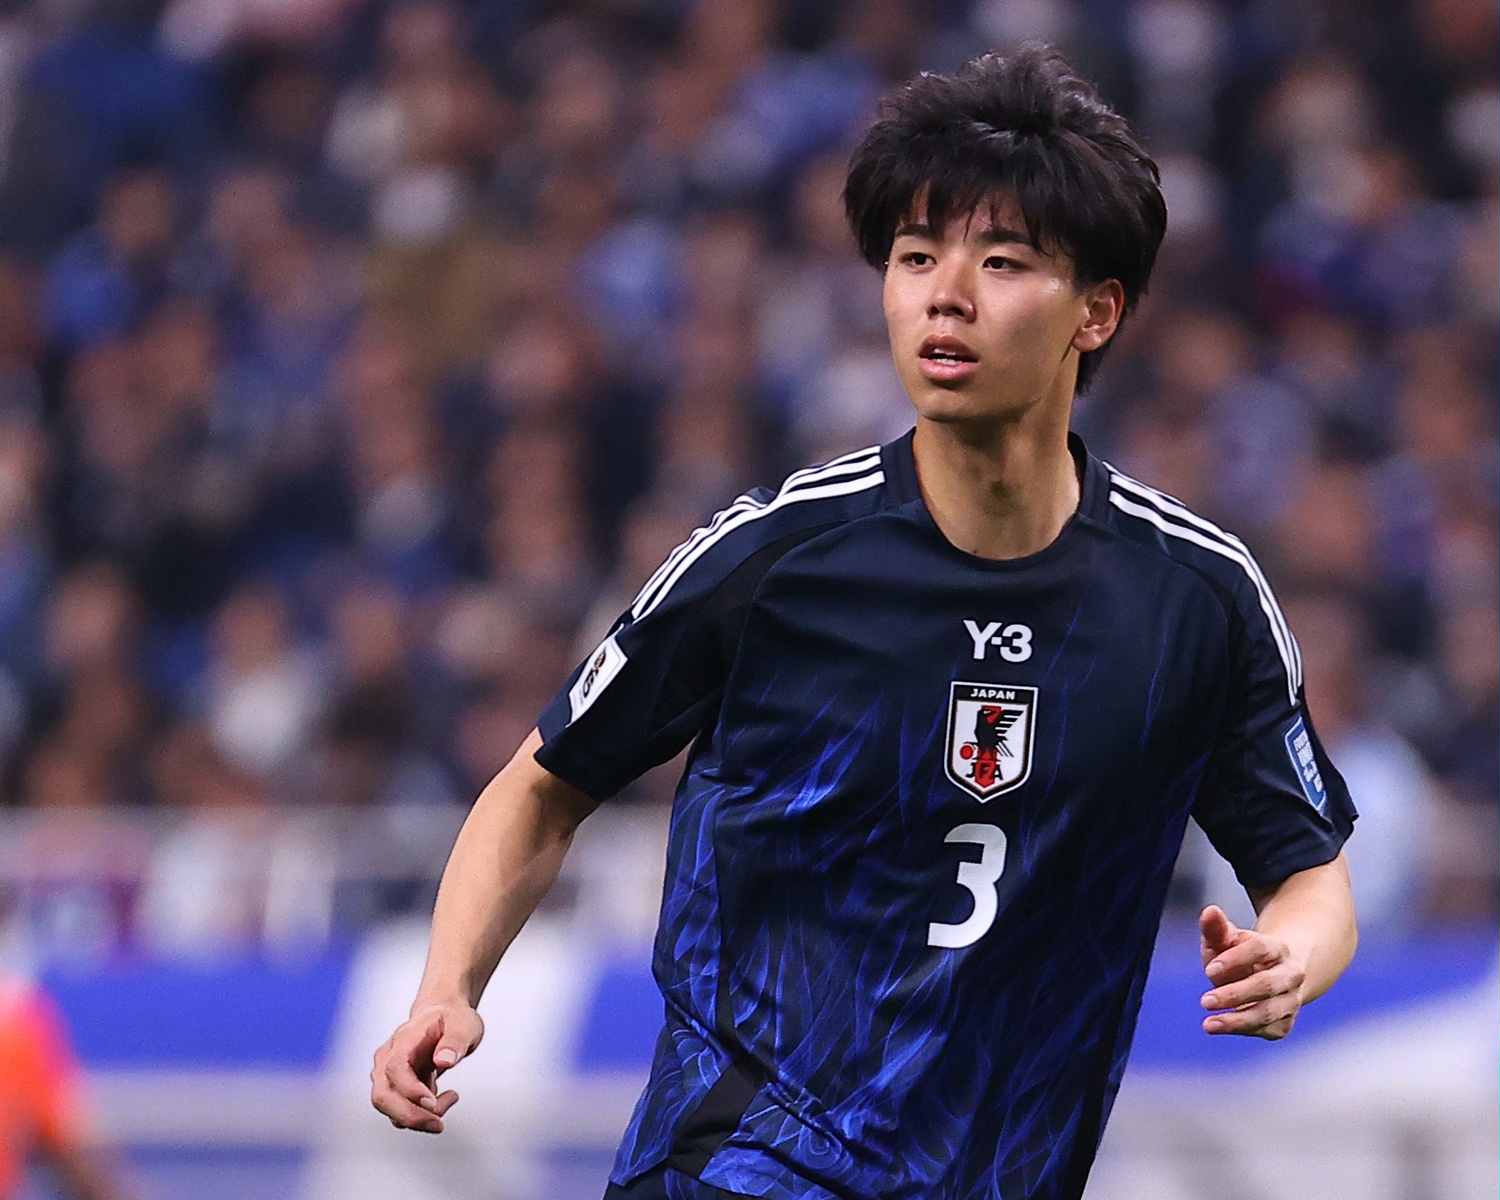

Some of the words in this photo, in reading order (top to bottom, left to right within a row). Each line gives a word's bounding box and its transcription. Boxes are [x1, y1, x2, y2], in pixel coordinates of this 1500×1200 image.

[962, 619, 1033, 663] Y-3
[970, 688, 1015, 700] JAPAN
[965, 761, 1004, 781] JFA
[927, 823, 1007, 949] 3
